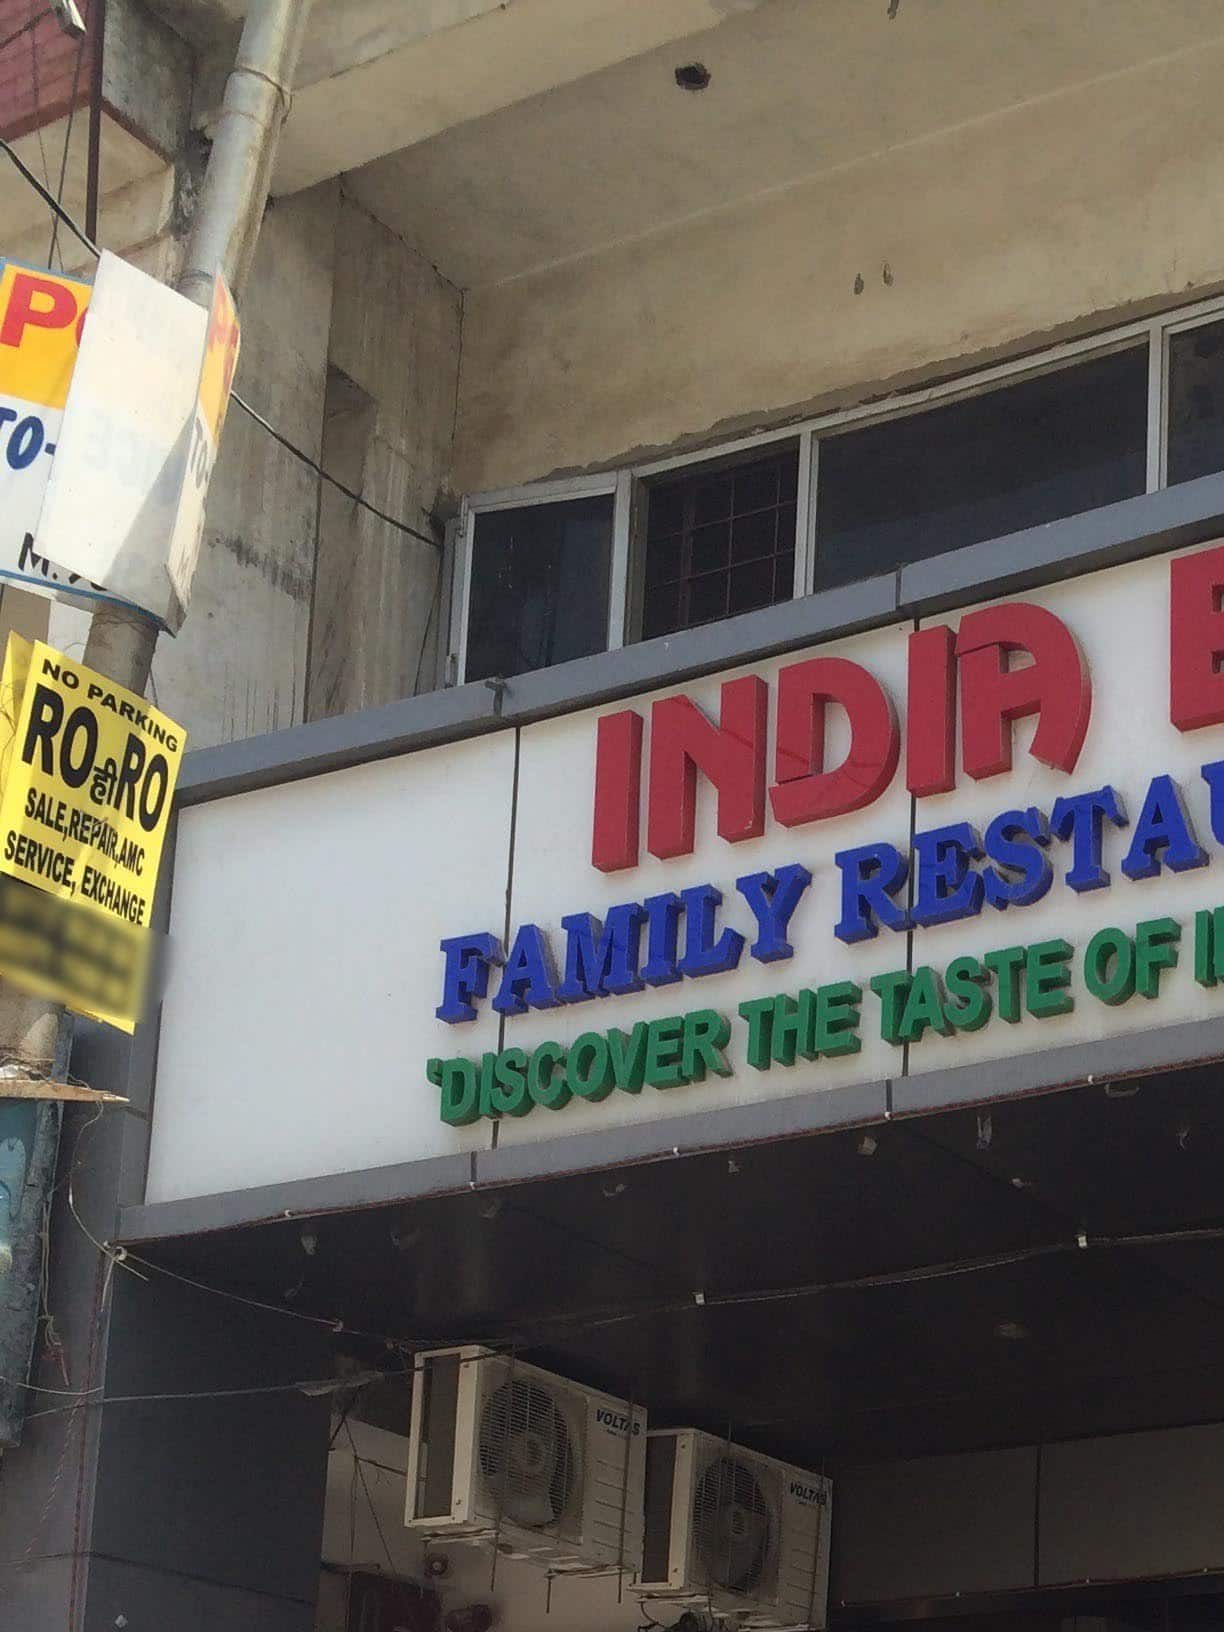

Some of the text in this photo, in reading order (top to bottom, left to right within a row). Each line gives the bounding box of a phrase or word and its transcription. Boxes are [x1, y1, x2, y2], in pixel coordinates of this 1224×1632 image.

[21, 682, 99, 790] RO
[117, 731, 170, 834] RO
[41, 658, 179, 754] NO PARKING
[592, 600, 1092, 872] INDIA
[3, 829, 147, 927] SERVICE, EXCHANGE
[436, 862, 811, 1025] FAMILY
[739, 979, 863, 1070] THE
[870, 938, 1074, 1046] TASTE
[1083, 917, 1181, 1006] OF
[596, 1408, 640, 1436] VOLTAS
